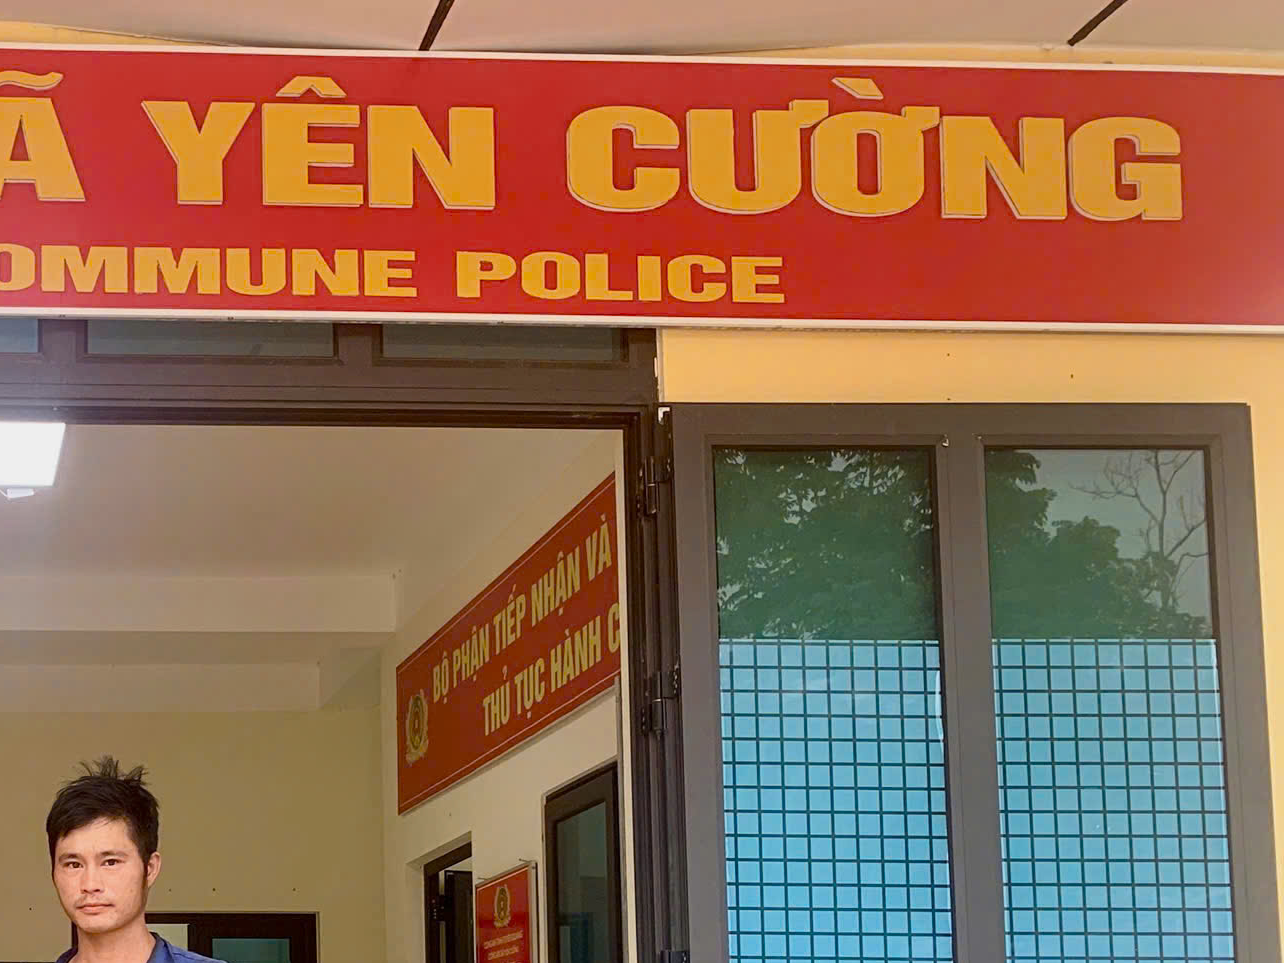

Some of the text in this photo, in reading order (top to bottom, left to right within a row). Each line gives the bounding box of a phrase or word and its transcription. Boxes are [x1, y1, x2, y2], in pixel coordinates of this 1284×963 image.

[141, 76, 495, 211] YÊN
[567, 77, 1183, 222] CƯỜNG
[456, 251, 785, 305] POLICE
[432, 651, 449, 704] BỘ
[453, 625, 490, 688] PHẬN
[493, 584, 526, 655] TIẾP
[531, 546, 580, 627] NHẬN
[585, 513, 612, 582] VÀ
[483, 665, 510, 736] THỦ
[514, 657, 545, 719] TỤC
[550, 615, 602, 693] HÀNH
